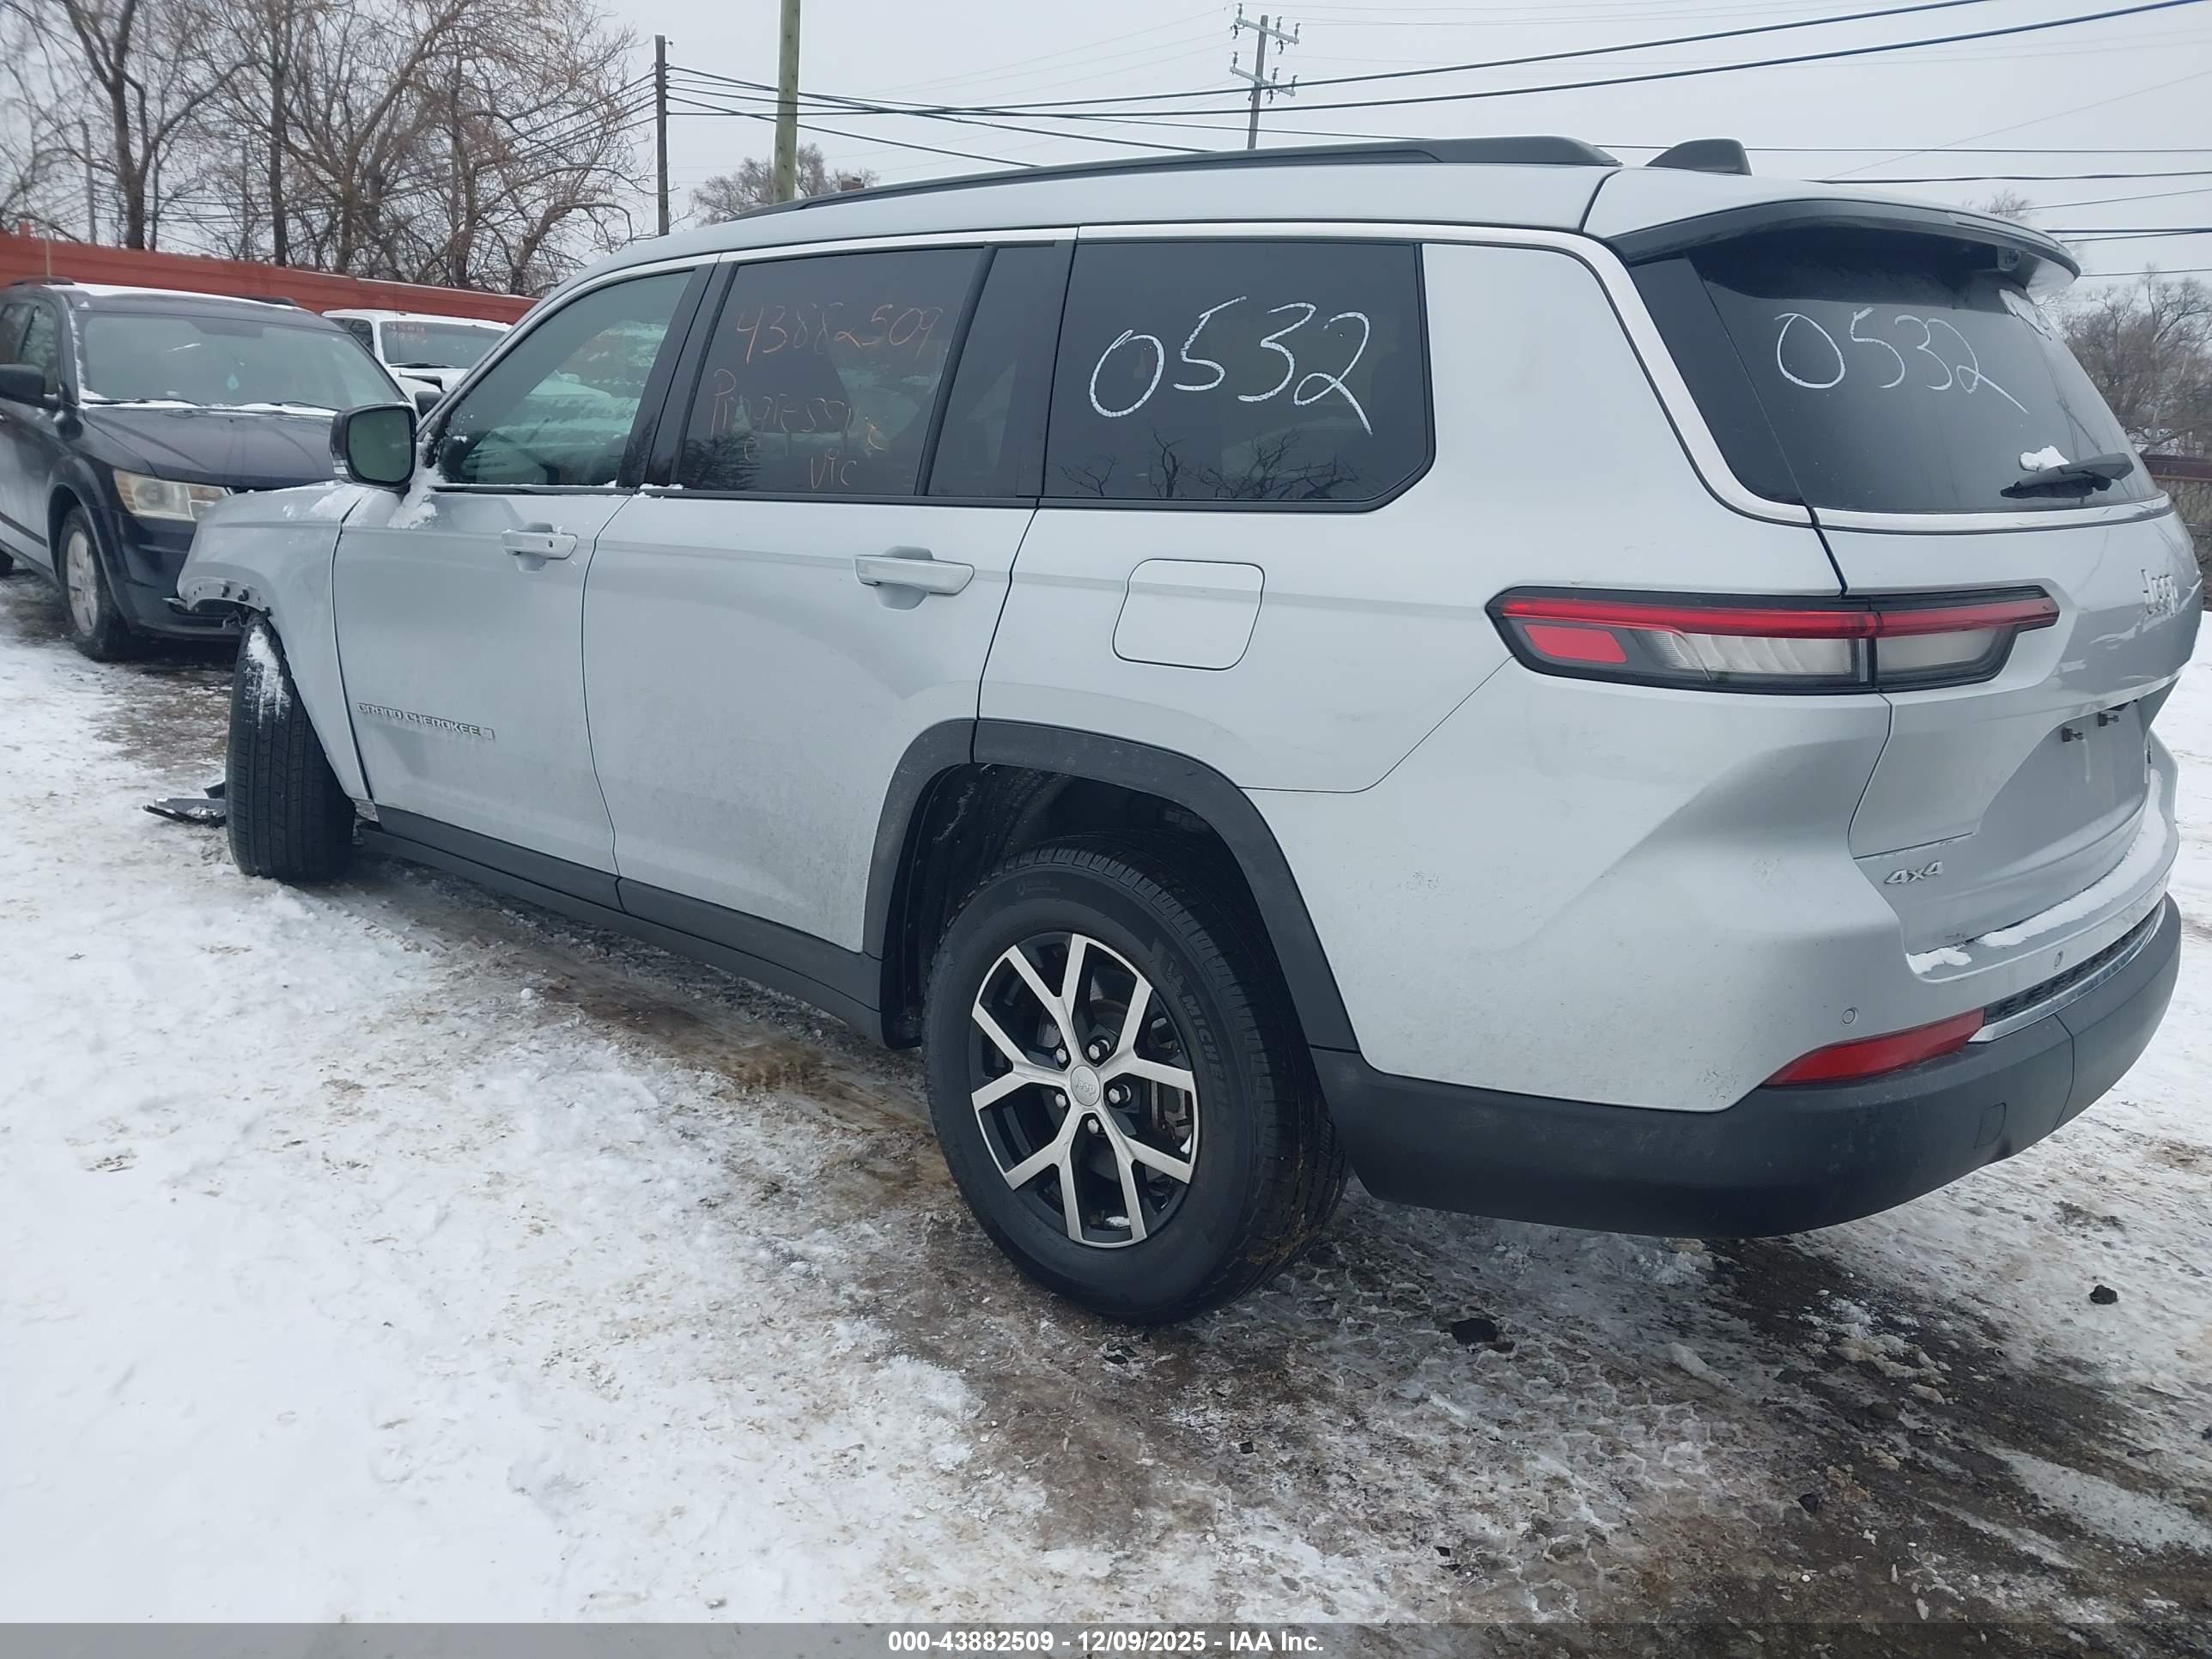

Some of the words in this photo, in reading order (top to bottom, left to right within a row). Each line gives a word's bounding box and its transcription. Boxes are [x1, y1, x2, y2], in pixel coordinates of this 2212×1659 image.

[1089, 295, 1373, 434] 0532
[1774, 306, 2029, 415] 0532
[356, 702, 404, 720] GRAND
[405, 710, 482, 736] CHEROKEE
[1884, 860, 1942, 884] 4x4
